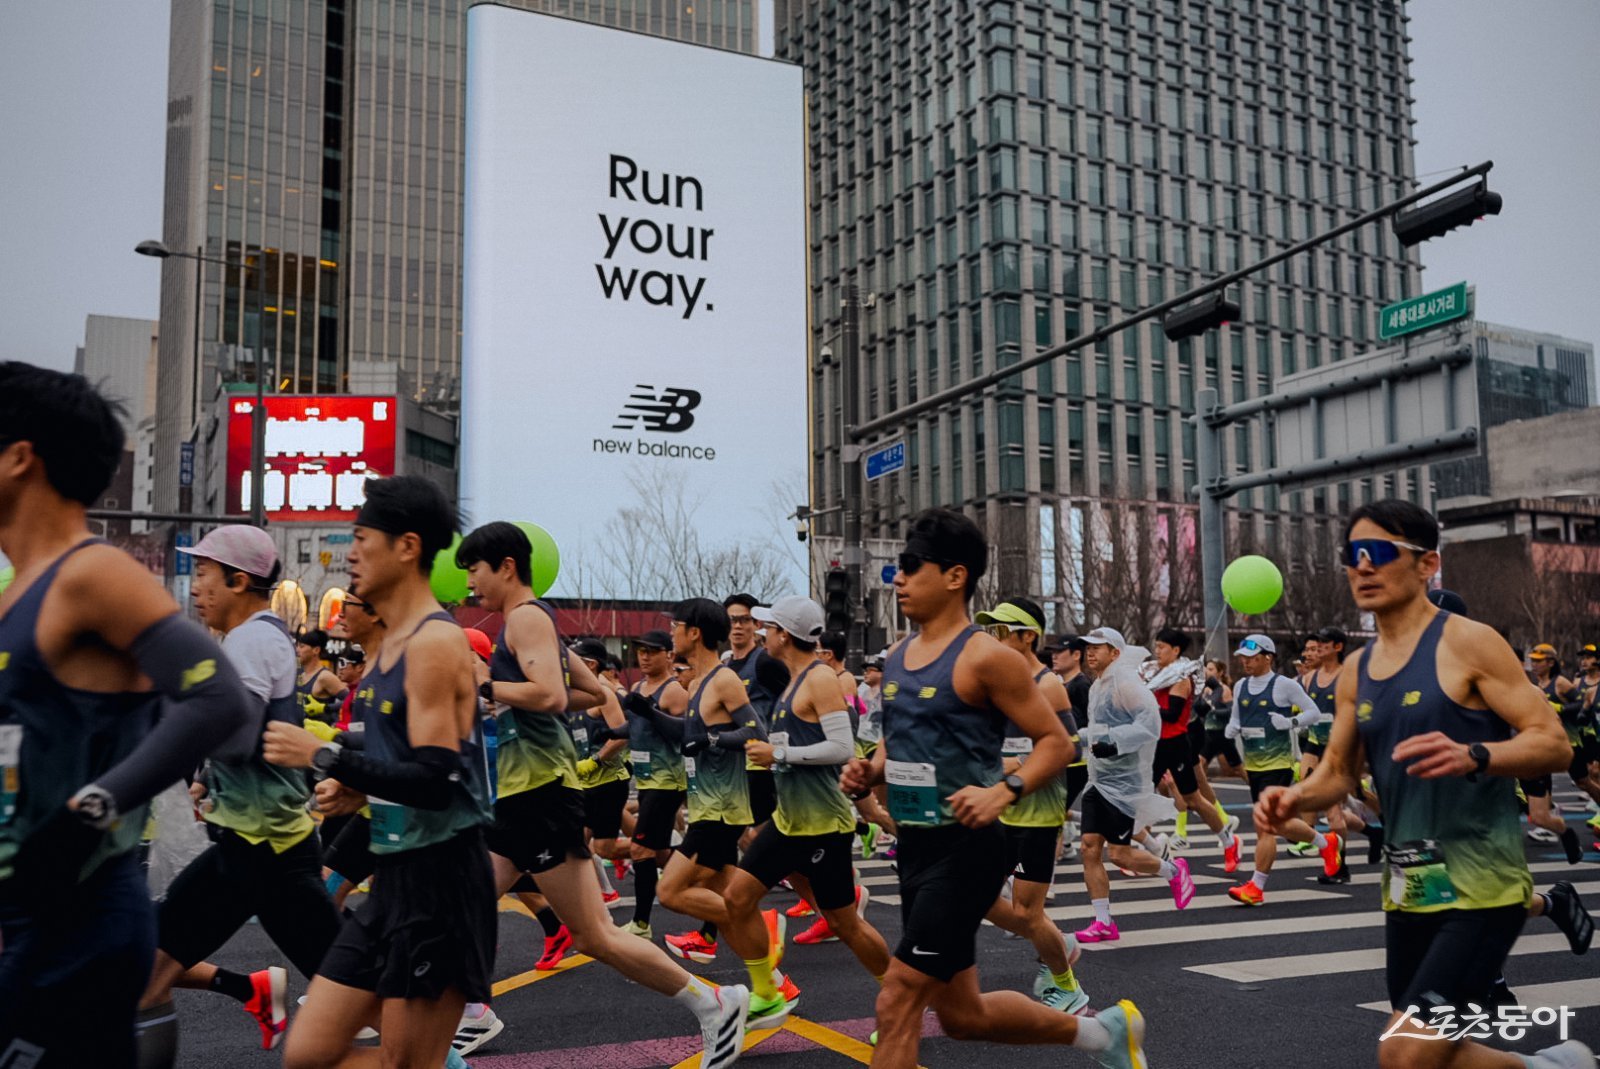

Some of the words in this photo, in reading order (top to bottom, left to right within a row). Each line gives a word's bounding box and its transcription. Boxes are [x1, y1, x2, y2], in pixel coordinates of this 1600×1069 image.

[609, 154, 703, 212] Run
[598, 213, 715, 261] your
[595, 264, 714, 320] way.
[1388, 292, 1456, 329] 세종대로사거리
[593, 438, 632, 454] new
[637, 438, 716, 460] balance
